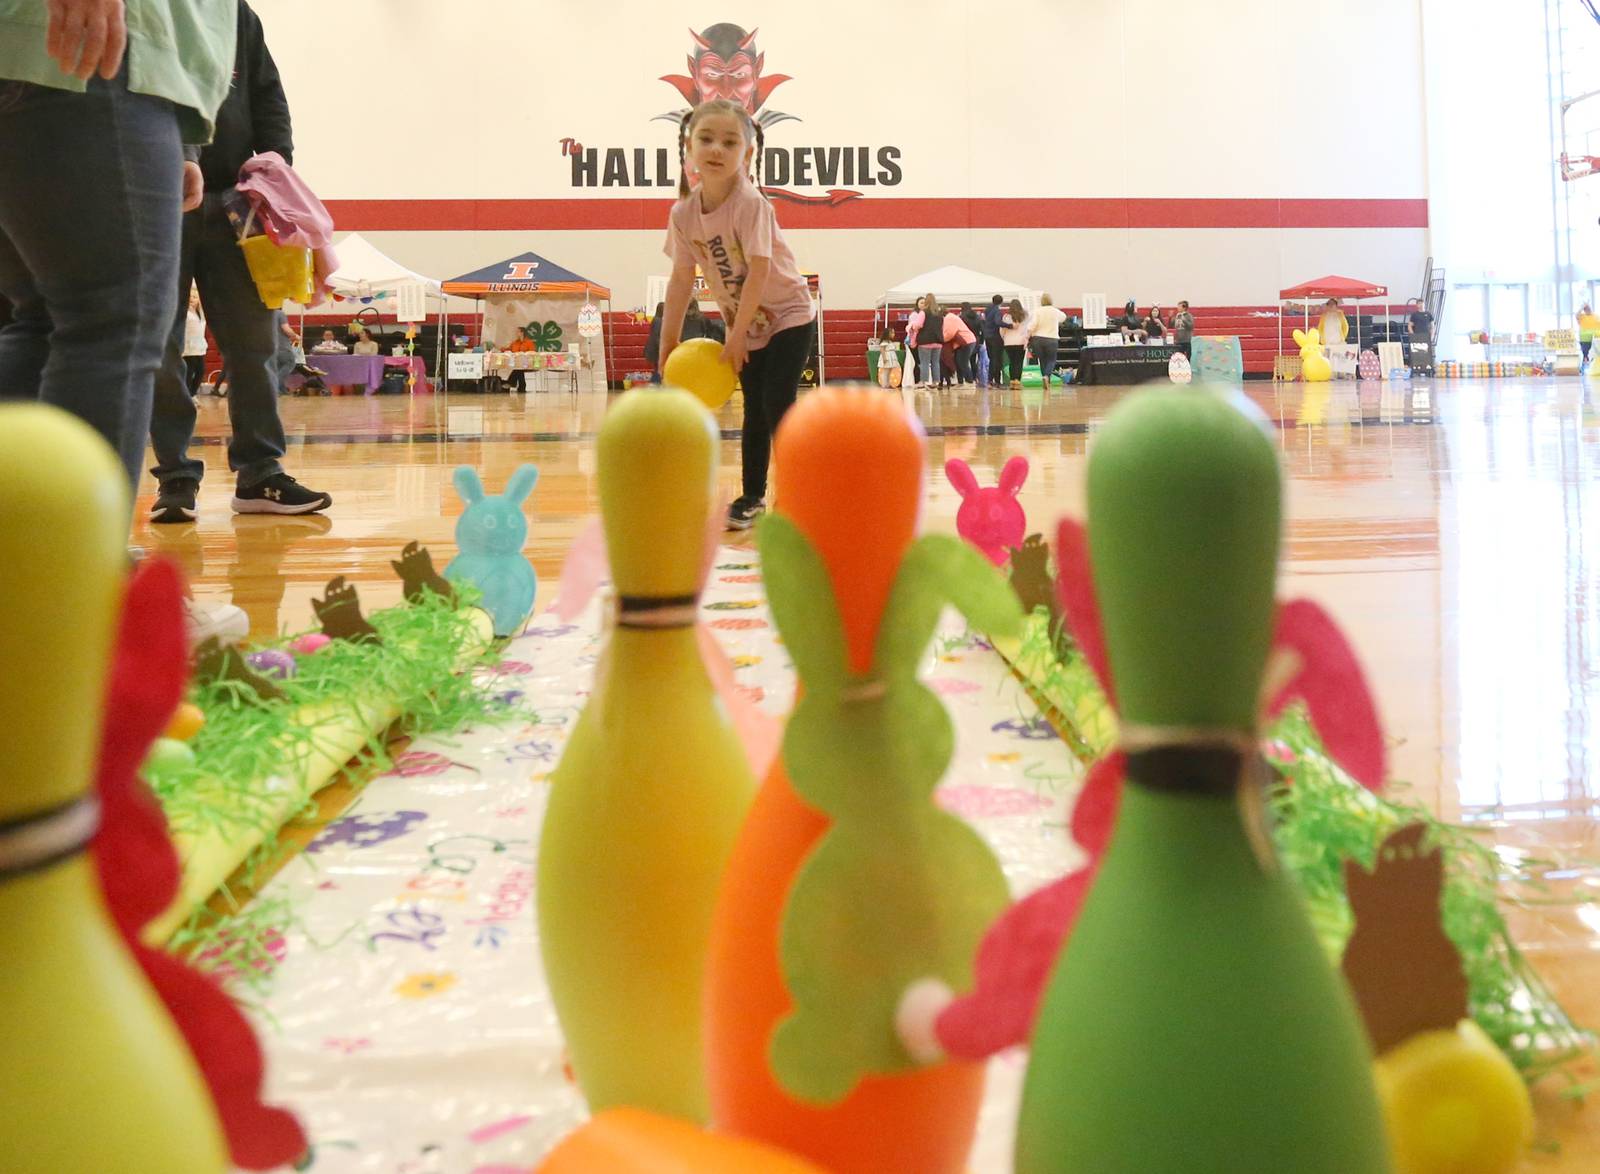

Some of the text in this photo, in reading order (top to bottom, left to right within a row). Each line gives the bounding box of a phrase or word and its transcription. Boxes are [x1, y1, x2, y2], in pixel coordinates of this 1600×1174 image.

[571, 146, 903, 187] HALL DEVILS
[488, 283, 540, 292] ILLINOIS
